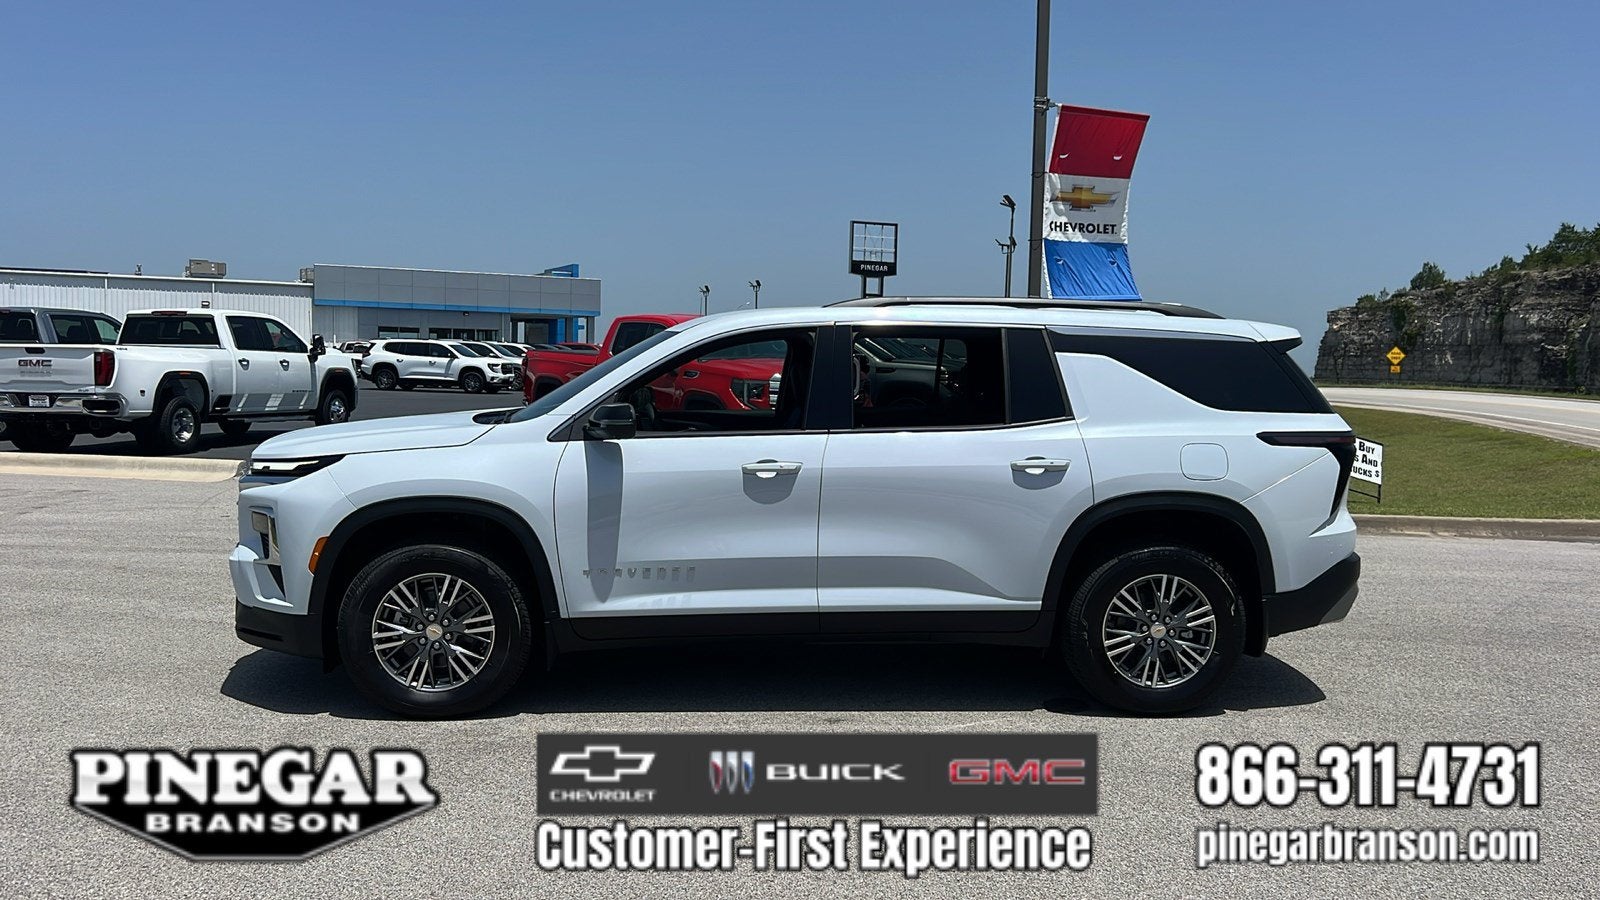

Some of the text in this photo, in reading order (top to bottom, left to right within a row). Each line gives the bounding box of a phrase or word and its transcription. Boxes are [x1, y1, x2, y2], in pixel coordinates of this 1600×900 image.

[860, 264, 888, 272] PINEGAR
[18, 359, 53, 367] GMC
[1352, 467, 1372, 478] UCKS
